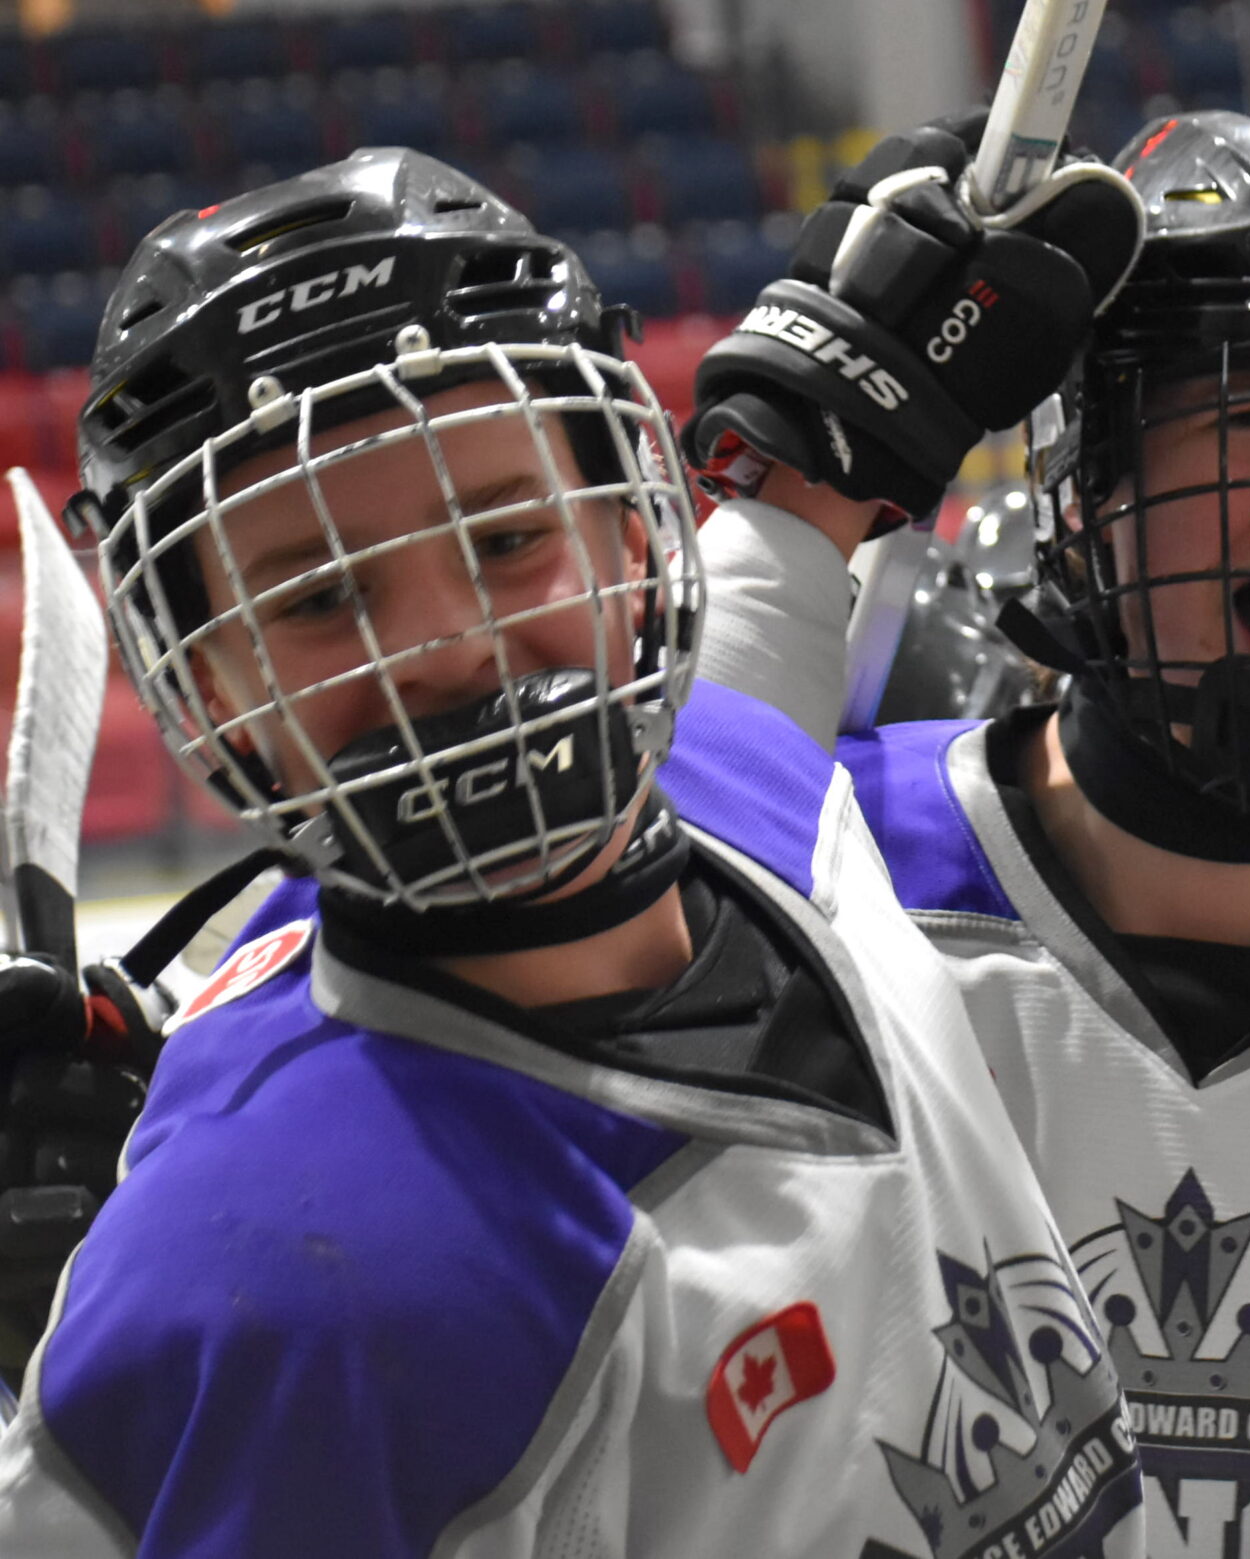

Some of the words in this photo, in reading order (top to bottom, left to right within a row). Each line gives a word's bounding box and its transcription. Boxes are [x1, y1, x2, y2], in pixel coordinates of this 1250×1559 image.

[236, 255, 396, 335] CCM
[397, 733, 574, 824] CCM
[1127, 1401, 1240, 1440] DWARD
[1024, 1436, 1114, 1552] EDWARD
